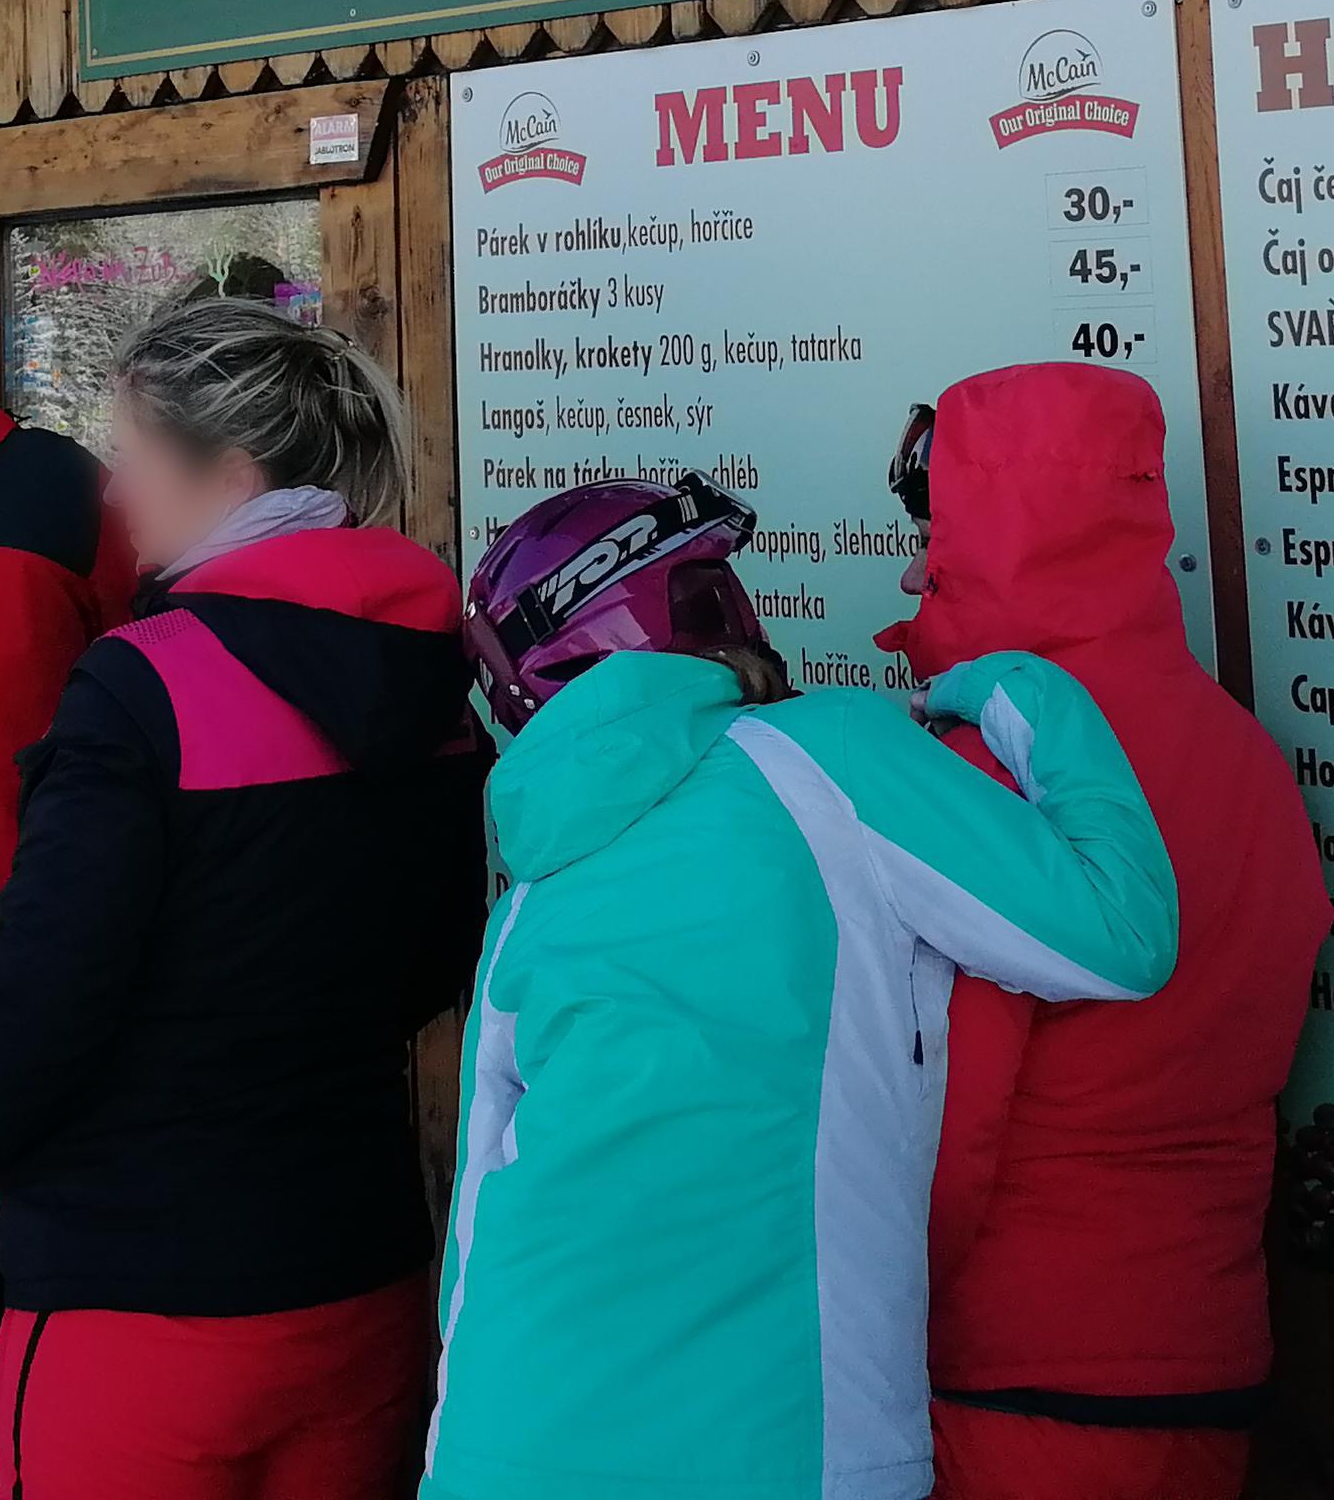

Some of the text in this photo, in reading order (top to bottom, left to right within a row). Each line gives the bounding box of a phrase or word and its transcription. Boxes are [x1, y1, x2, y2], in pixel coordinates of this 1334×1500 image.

[1027, 50, 1098, 92] McCain
[505, 109, 557, 146] McCain
[655, 66, 904, 167] MENU
[999, 100, 1129, 137] Our Original Choice
[314, 143, 356, 156] JABLOTRON
[484, 153, 579, 183] Our Original Choice
[1062, 185, 1134, 225] 30,-
[1258, 157, 1303, 214] Čaj
[476, 223, 531, 258] Párek
[536, 231, 548, 254] v
[690, 208, 754, 244] hořčice
[1068, 248, 1142, 292] 45,-
[1262, 228, 1308, 286] Čaj
[478, 273, 665, 319] Bramboráčky 3 kusy
[479, 325, 862, 380] Hranolky, krokety 200 g, kečup, tatarka
[1071, 322, 1146, 361] 40,-
[481, 393, 714, 439] Langoš, kečup, česnek, sýr
[483, 456, 537, 490] Párek
[543, 465, 566, 490] na
[754, 582, 826, 620] tatarka
[802, 647, 876, 692] hořčice,
